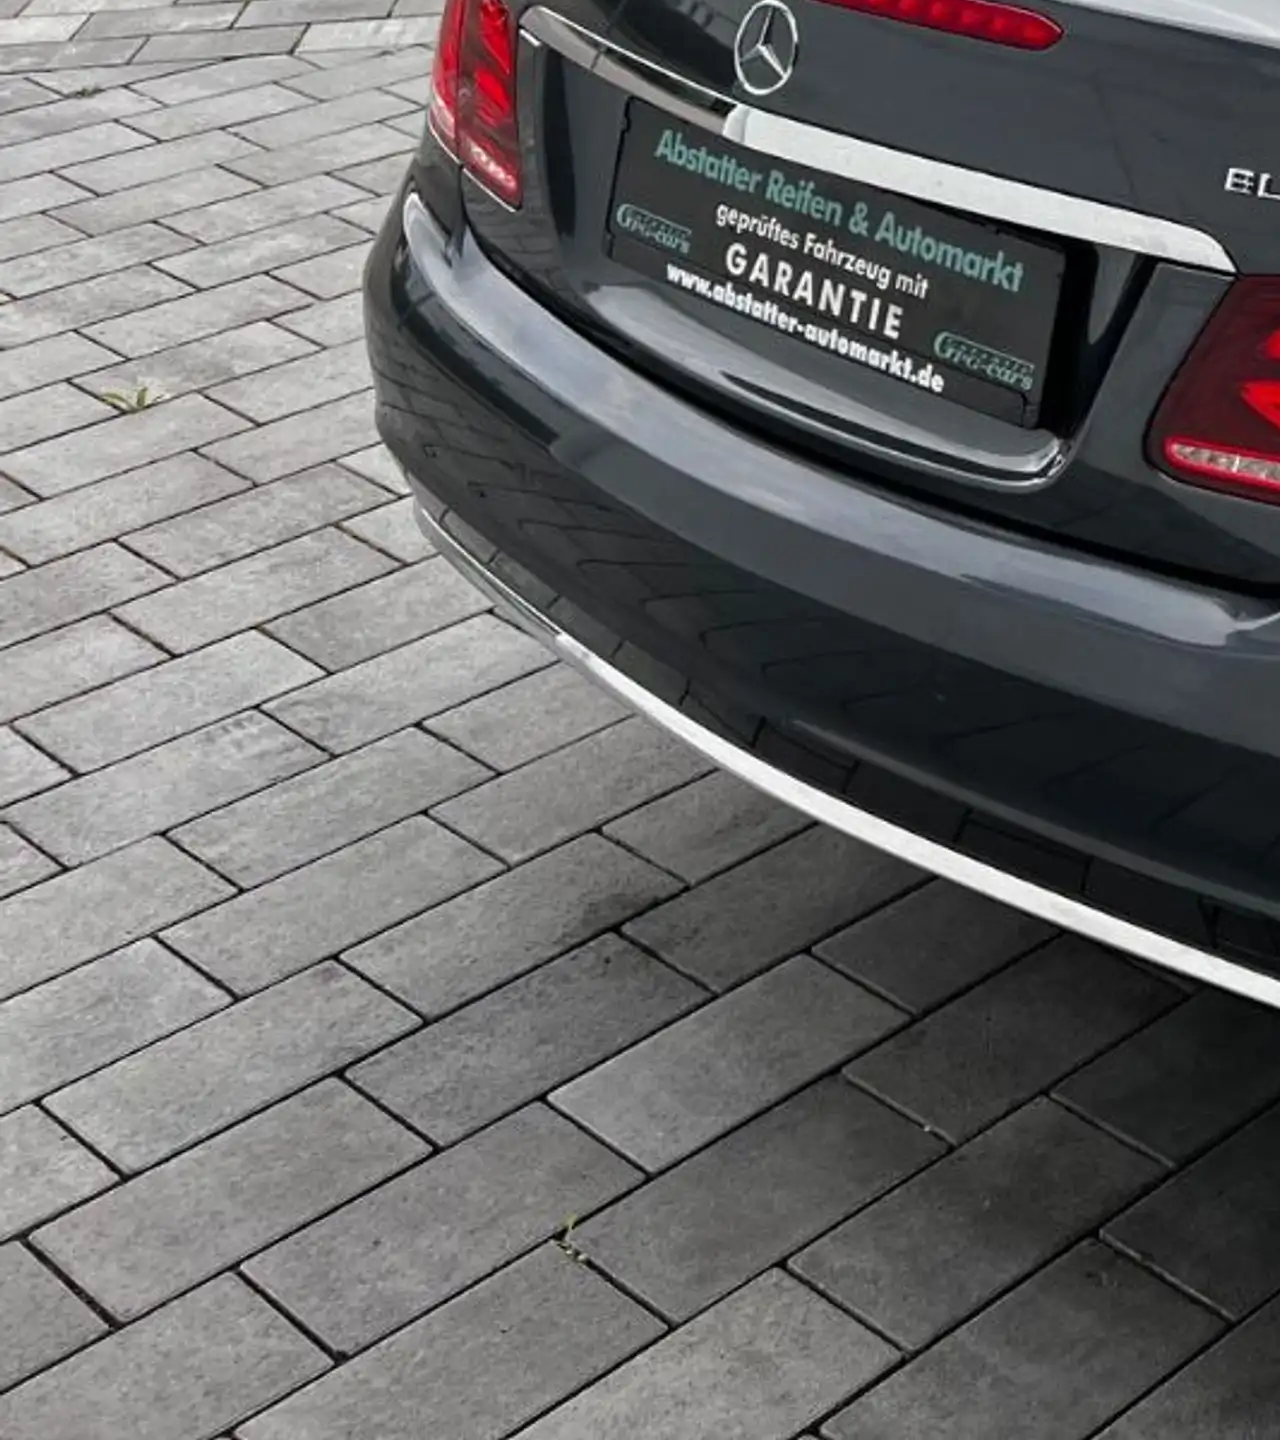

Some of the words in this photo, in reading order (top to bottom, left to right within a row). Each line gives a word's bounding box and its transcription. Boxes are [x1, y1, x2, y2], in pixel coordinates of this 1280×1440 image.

[654, 129, 762, 194] Abstatter
[765, 169, 843, 227] Reifen
[848, 201, 869, 238] &
[874, 211, 1024, 293] Automarkt
[715, 203, 801, 250] geprüftes
[803, 231, 891, 291] Fahrzeug
[895, 271, 929, 300] mit
[666, 263, 945, 394] www.abstatter-automarkt.de
[725, 242, 904, 340] GARANTIE
